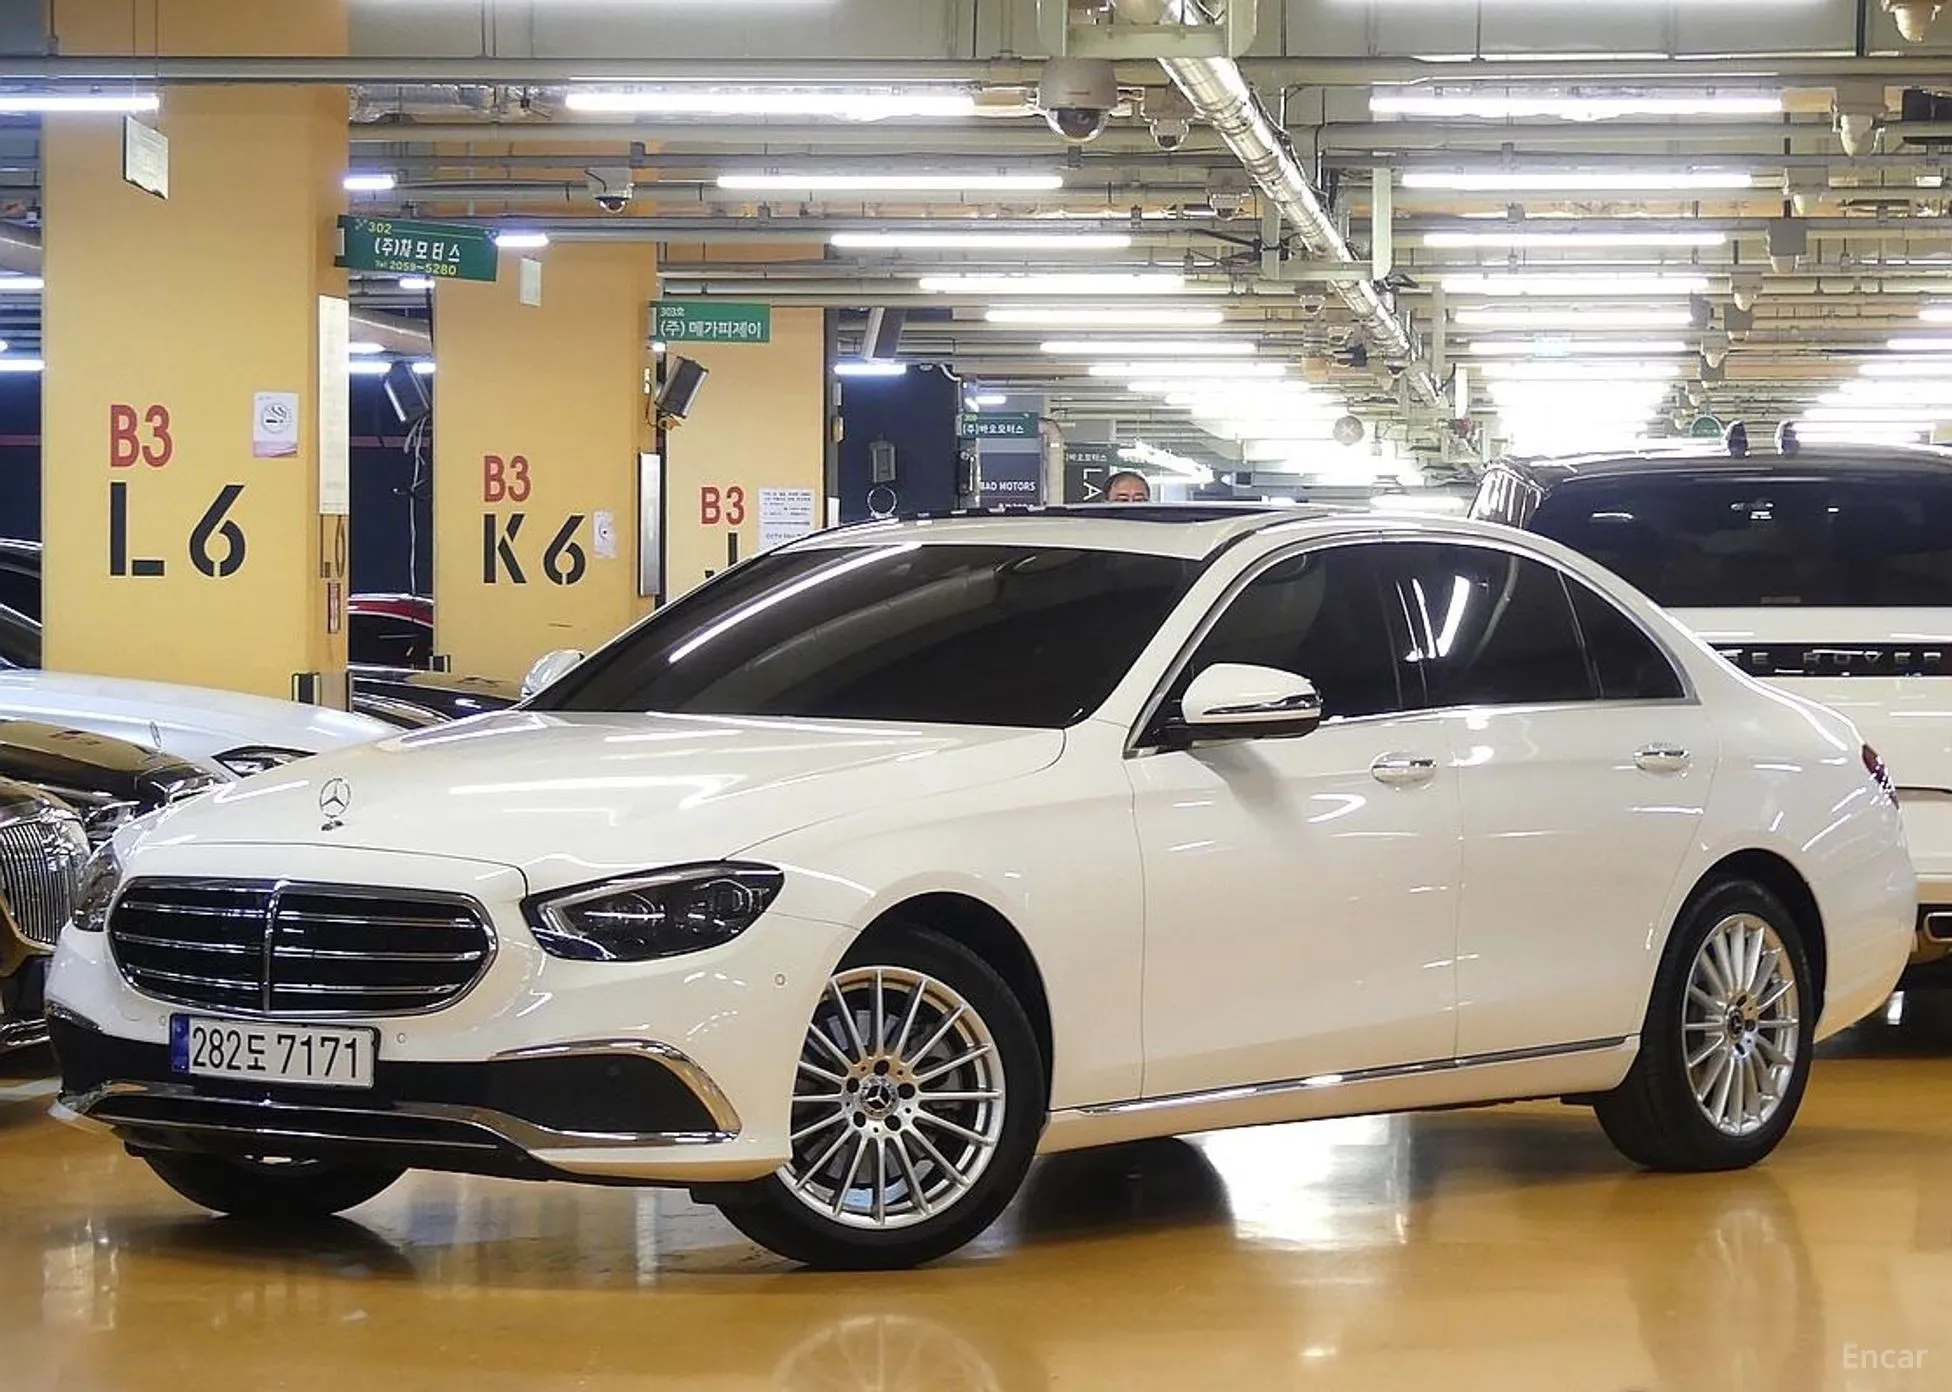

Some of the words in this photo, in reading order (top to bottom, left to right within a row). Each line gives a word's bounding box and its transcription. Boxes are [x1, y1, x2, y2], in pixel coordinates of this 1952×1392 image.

[367, 221, 393, 235] 302
[110, 404, 173, 468] B3
[484, 455, 532, 502] B3
[999, 481, 1036, 491] MOTORS
[701, 486, 745, 525] B3
[192, 1026, 266, 1071] 282도
[277, 1034, 358, 1078] 7171
